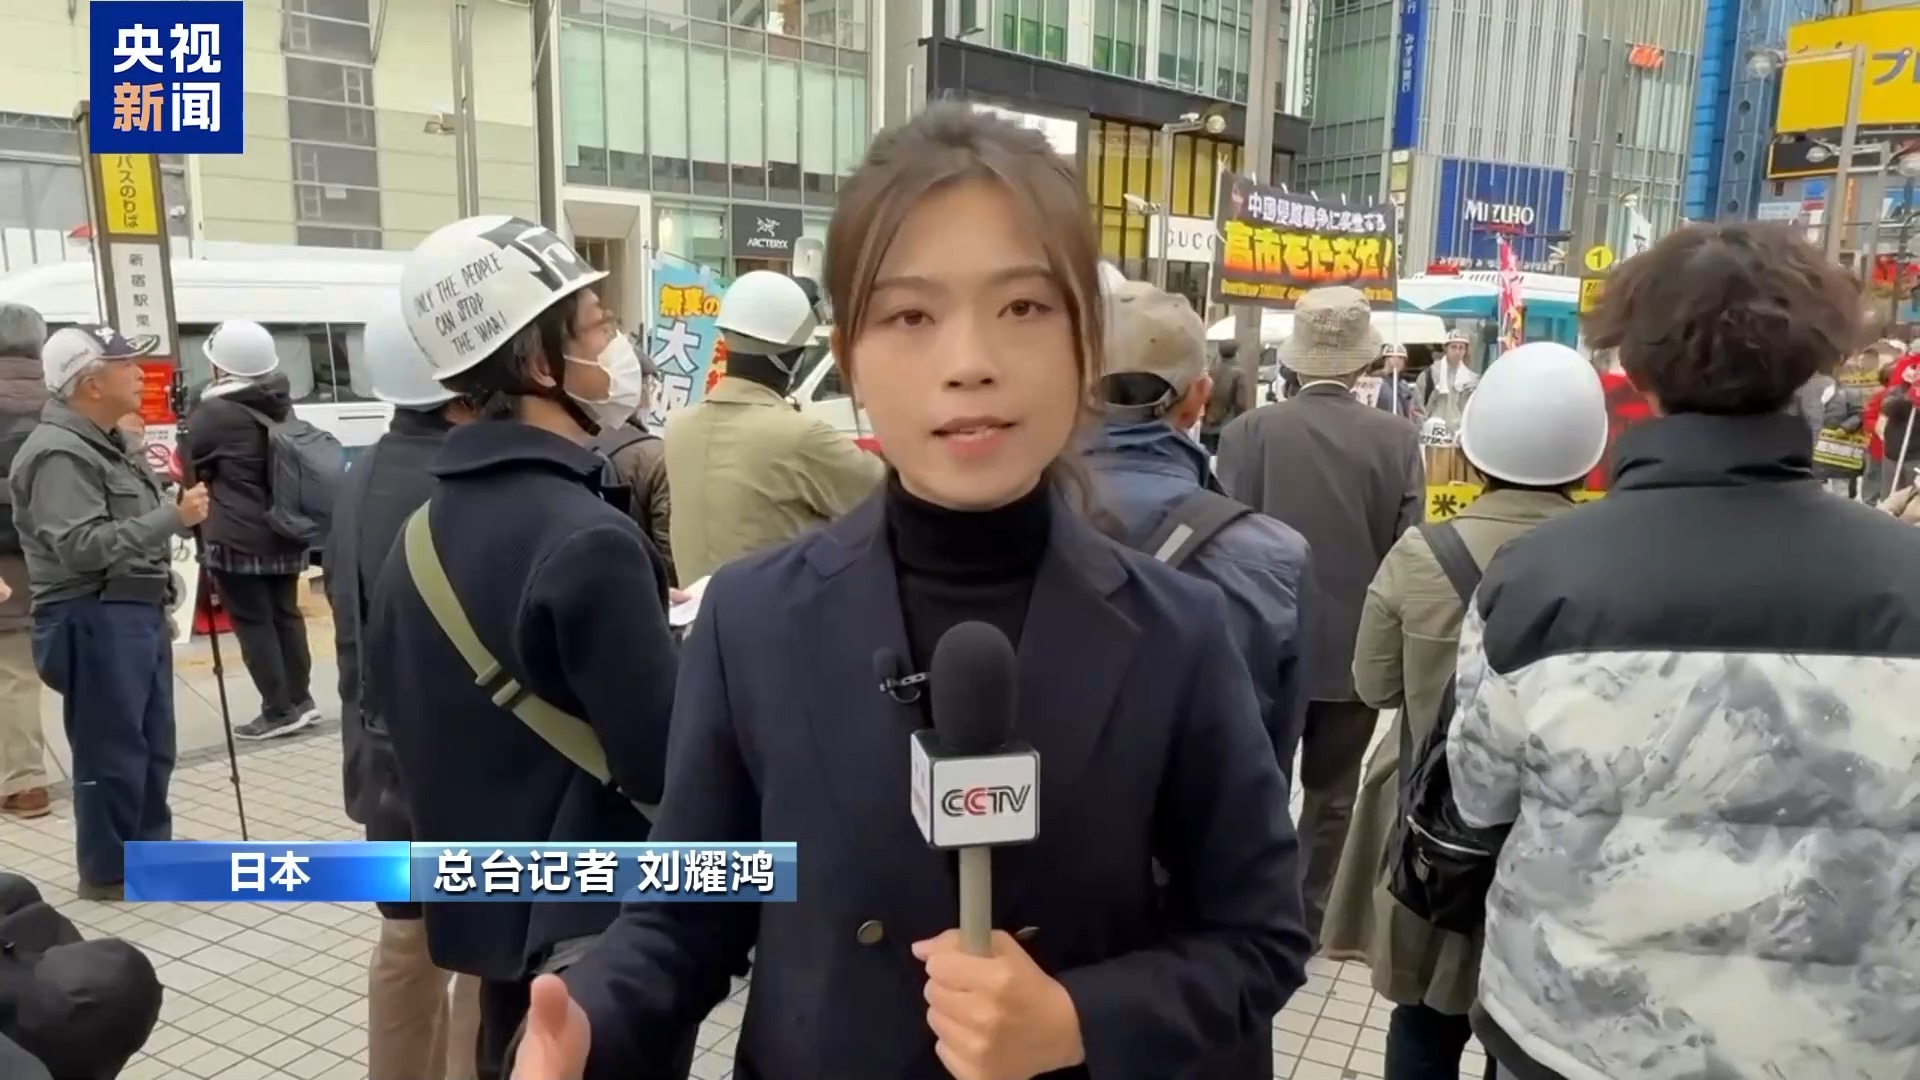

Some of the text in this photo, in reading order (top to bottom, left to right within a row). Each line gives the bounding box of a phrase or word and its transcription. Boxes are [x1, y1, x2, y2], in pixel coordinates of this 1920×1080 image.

[1872, 47, 1920, 85] プ
[117, 155, 138, 228] バスのりば
[1465, 200, 1534, 225] MIZUHO
[1591, 249, 1603, 269] 1
[414, 287, 434, 317] NLY
[436, 272, 460, 303] THE
[461, 252, 503, 288] PEOPLE
[435, 292, 485, 337] CAN STOP
[451, 331, 475, 356] THE
[1431, 493, 1478, 517] 米・
[942, 784, 1031, 817] CCTV
